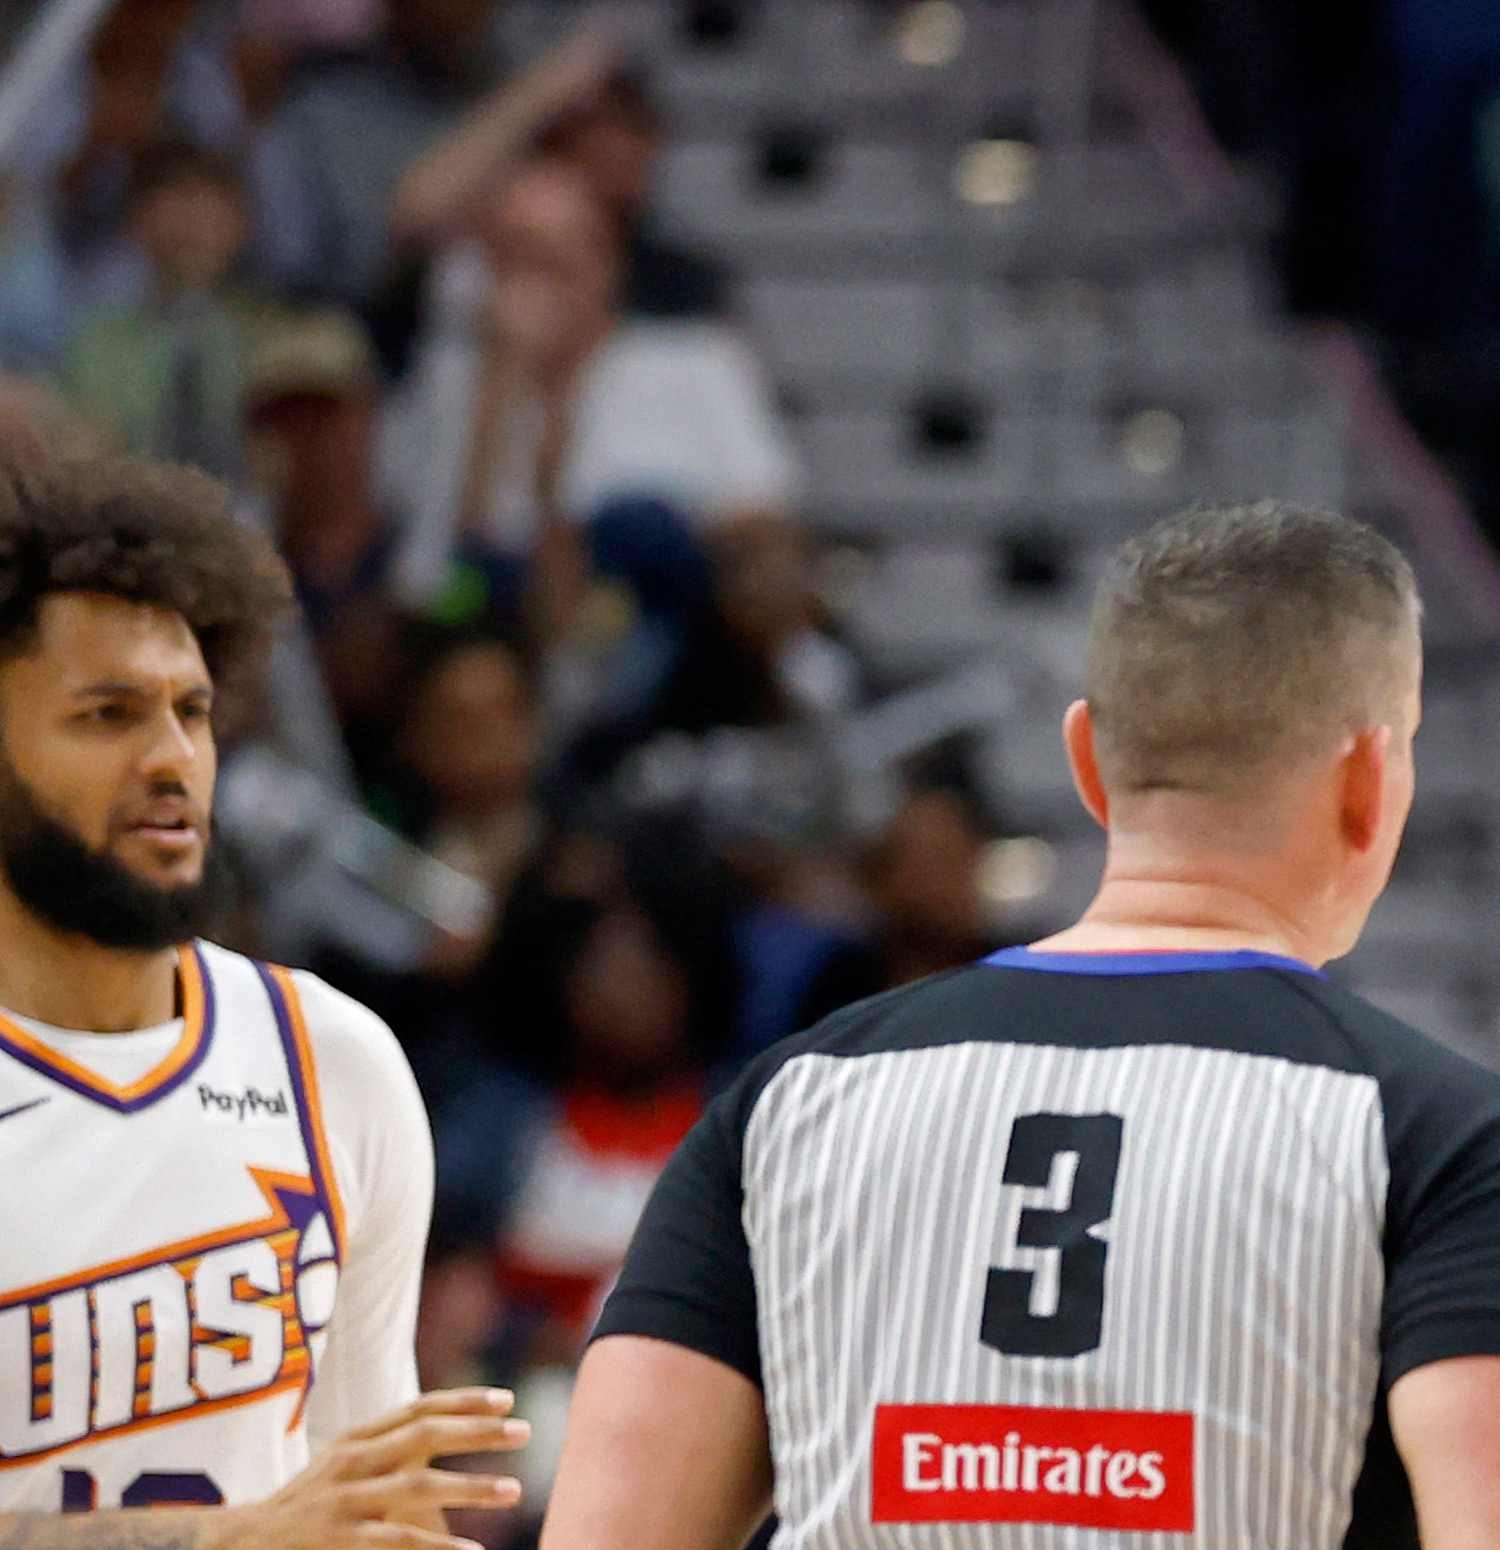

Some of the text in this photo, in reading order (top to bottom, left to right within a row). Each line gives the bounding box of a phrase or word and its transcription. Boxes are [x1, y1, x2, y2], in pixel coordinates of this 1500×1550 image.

[198, 1085, 288, 1122] PayPal
[980, 1110, 1126, 1358] 3
[902, 1431, 1167, 1500] Emirates
